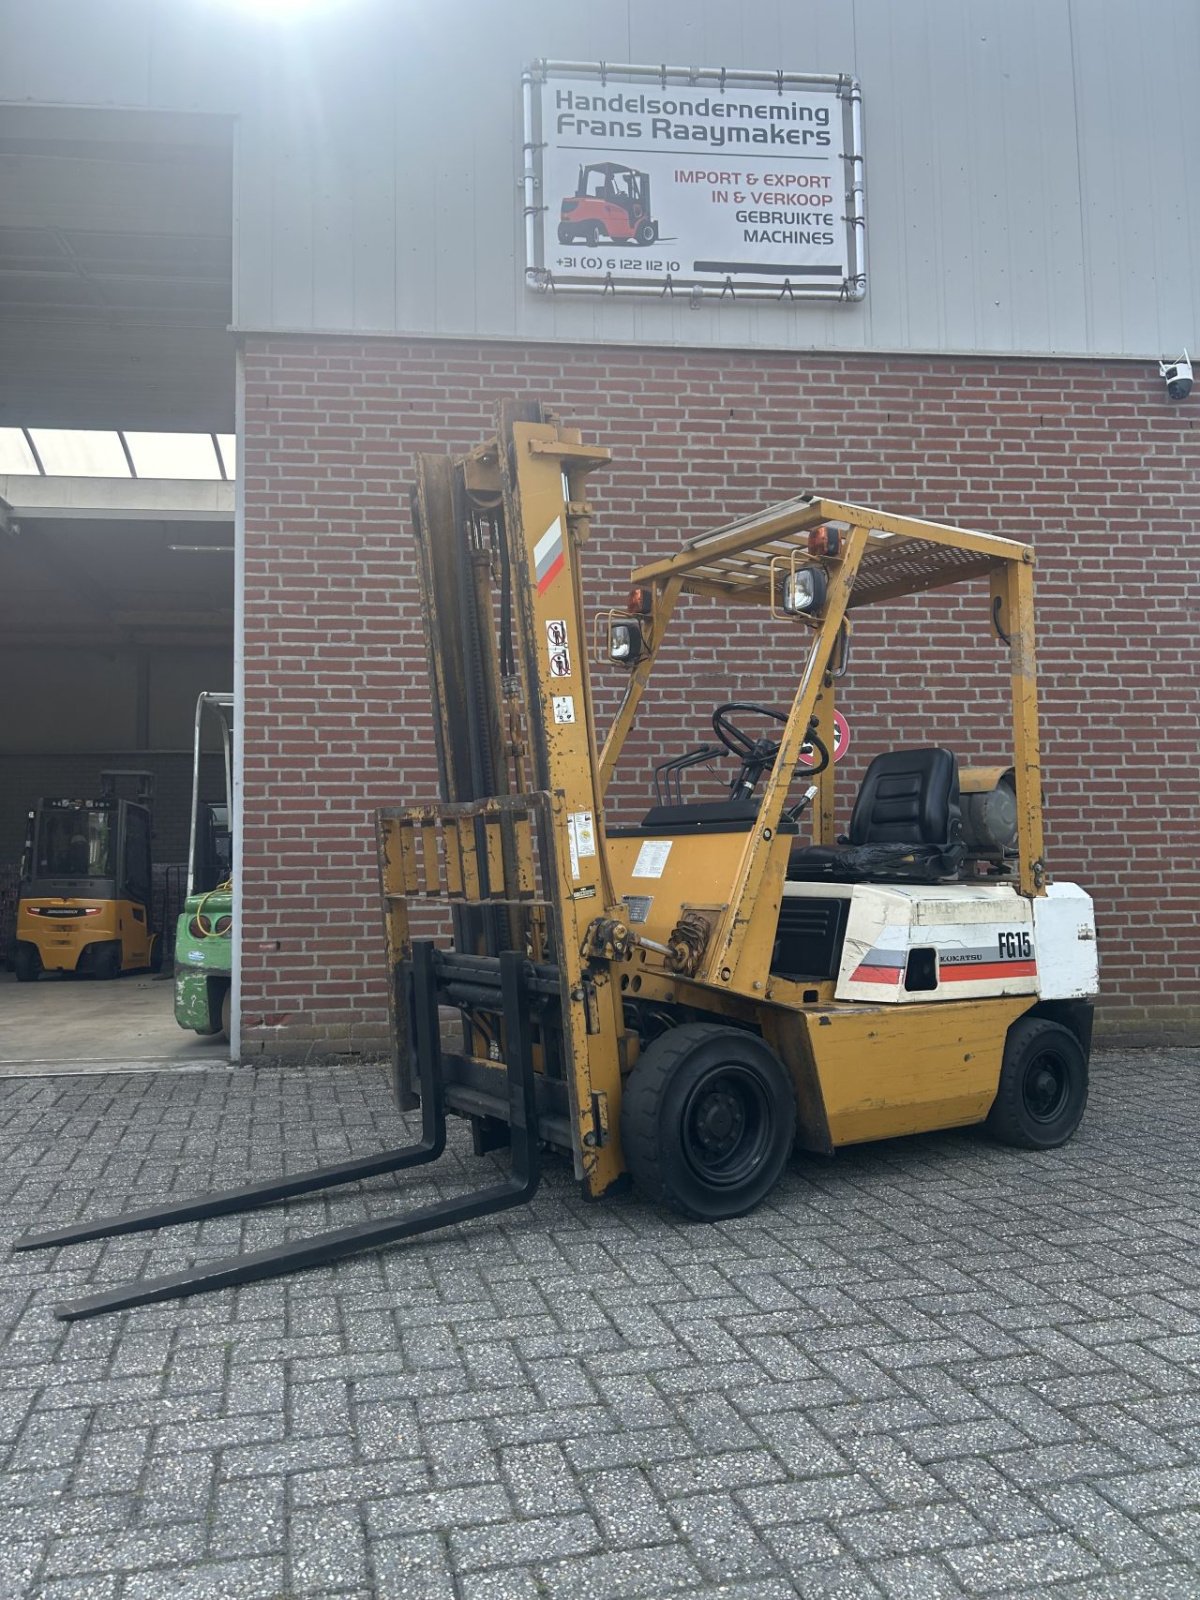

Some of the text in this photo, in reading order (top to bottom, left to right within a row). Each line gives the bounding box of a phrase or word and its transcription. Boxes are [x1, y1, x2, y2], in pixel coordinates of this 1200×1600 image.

[556, 90, 829, 126] Handelsonderneming
[557, 113, 831, 146] Frans Raaymakers
[674, 170, 831, 189] IMPORT & EXPORT
[712, 190, 833, 207] IN & VERKOOP
[736, 210, 833, 226] GEBRUIKTE
[744, 229, 834, 245] MACHINES
[556, 256, 681, 272] +31 (0) 6 122 112 10
[998, 931, 1031, 959] FG15
[940, 954, 983, 963] KOMATSU
